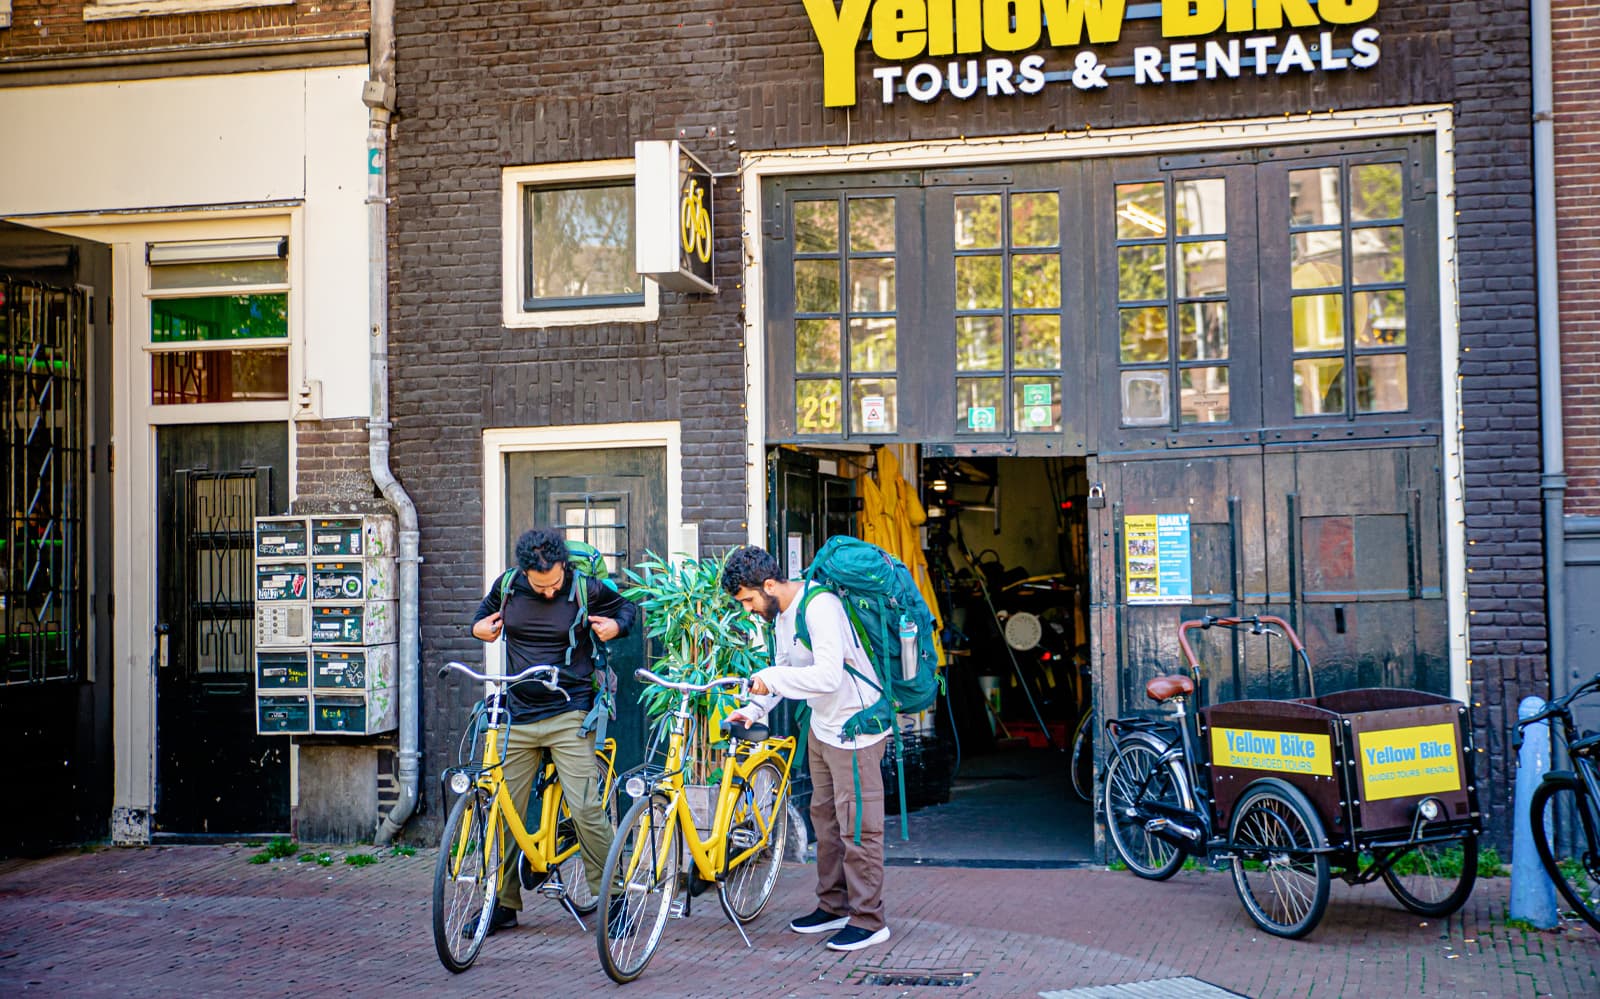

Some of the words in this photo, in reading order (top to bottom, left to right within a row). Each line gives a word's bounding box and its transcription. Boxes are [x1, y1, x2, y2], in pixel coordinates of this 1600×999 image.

[802, 0, 1126, 107] Yellow
[873, 54, 1045, 103] TOURS
[1071, 51, 1109, 88] &
[1134, 27, 1380, 84] RENTALS
[803, 396, 836, 428] 29
[1225, 730, 1275, 755] Yellow
[1280, 733, 1316, 758] Bike
[1365, 746, 1415, 766] Yellow
[1420, 741, 1452, 759] Bike
[1230, 754, 1250, 767] DAILY
[1252, 756, 1283, 769] GUIDED
[1285, 759, 1313, 772] TOURS
